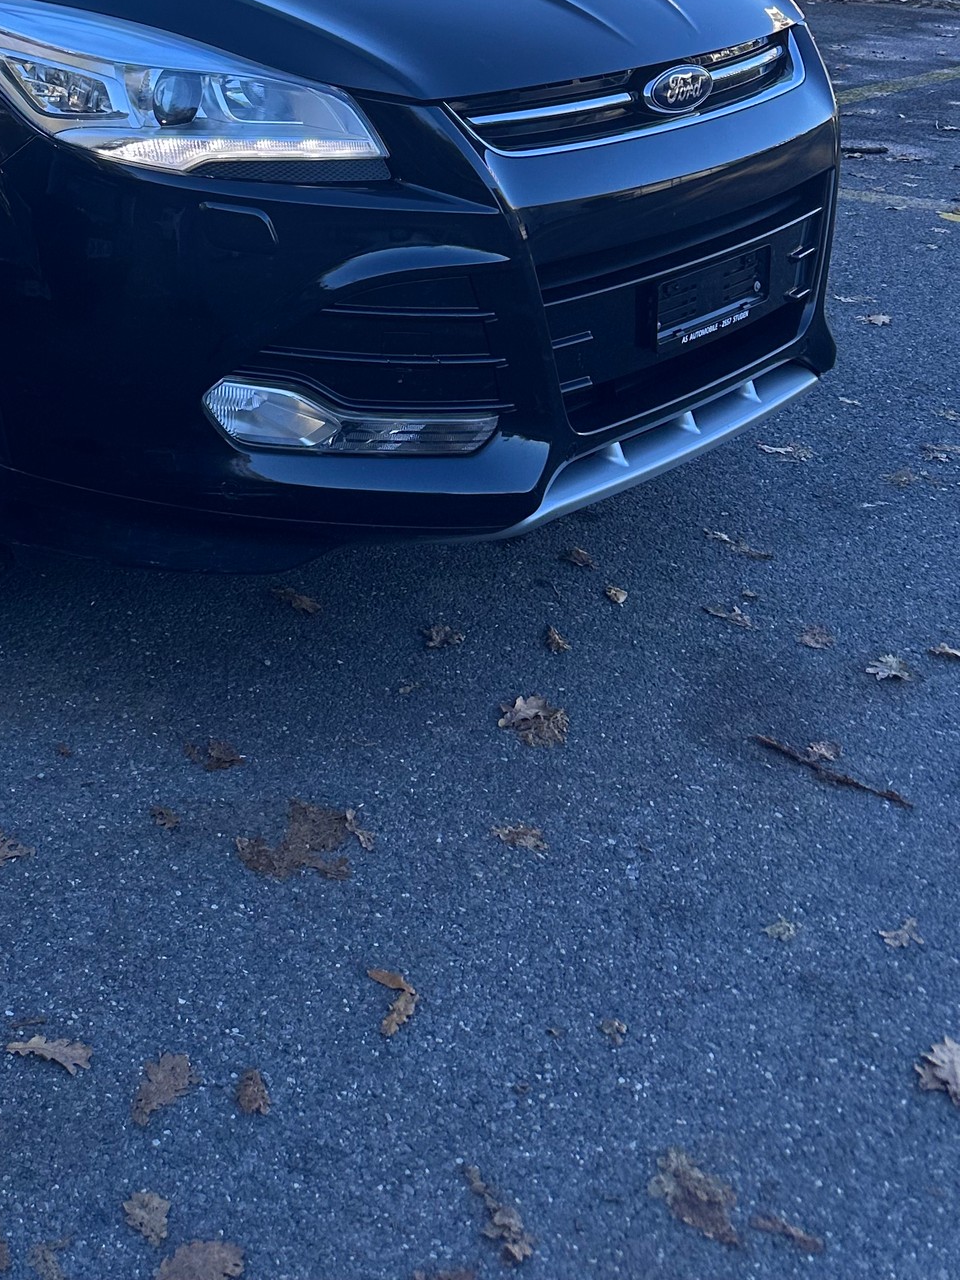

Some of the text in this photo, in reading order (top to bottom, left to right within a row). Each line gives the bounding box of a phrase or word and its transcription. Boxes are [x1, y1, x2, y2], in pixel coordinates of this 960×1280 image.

[667, 72, 708, 104] Ford
[681, 334, 689, 344] AS
[689, 322, 719, 341] AUTOMOBILE
[721, 317, 732, 328] 2557
[732, 310, 750, 323] STUDEN
